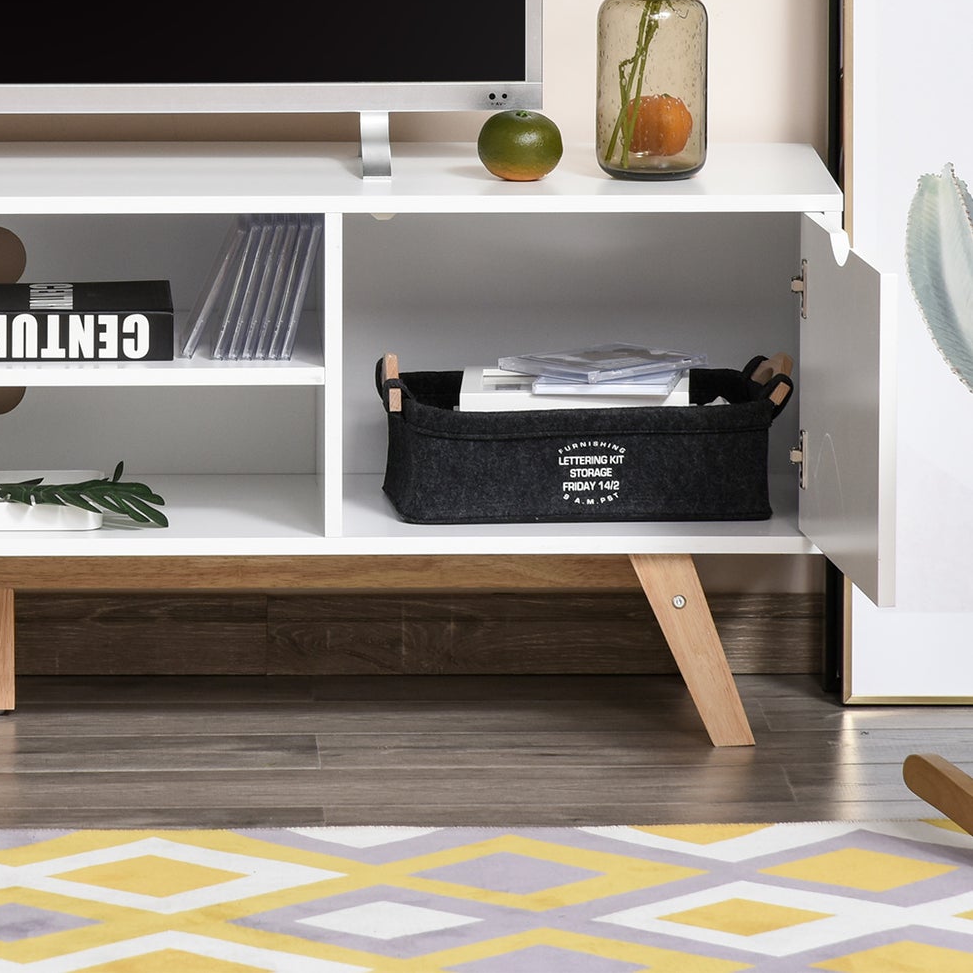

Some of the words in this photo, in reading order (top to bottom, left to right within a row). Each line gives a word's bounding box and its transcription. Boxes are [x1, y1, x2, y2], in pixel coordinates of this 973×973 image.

[558, 440, 626, 454] FURNISHING
[558, 456, 608, 466] LETTERING
[609, 455, 625, 464] KIT
[570, 468, 613, 478] STORAGE
[563, 481, 596, 491] FRIDAY
[598, 480, 620, 490] 14/2
